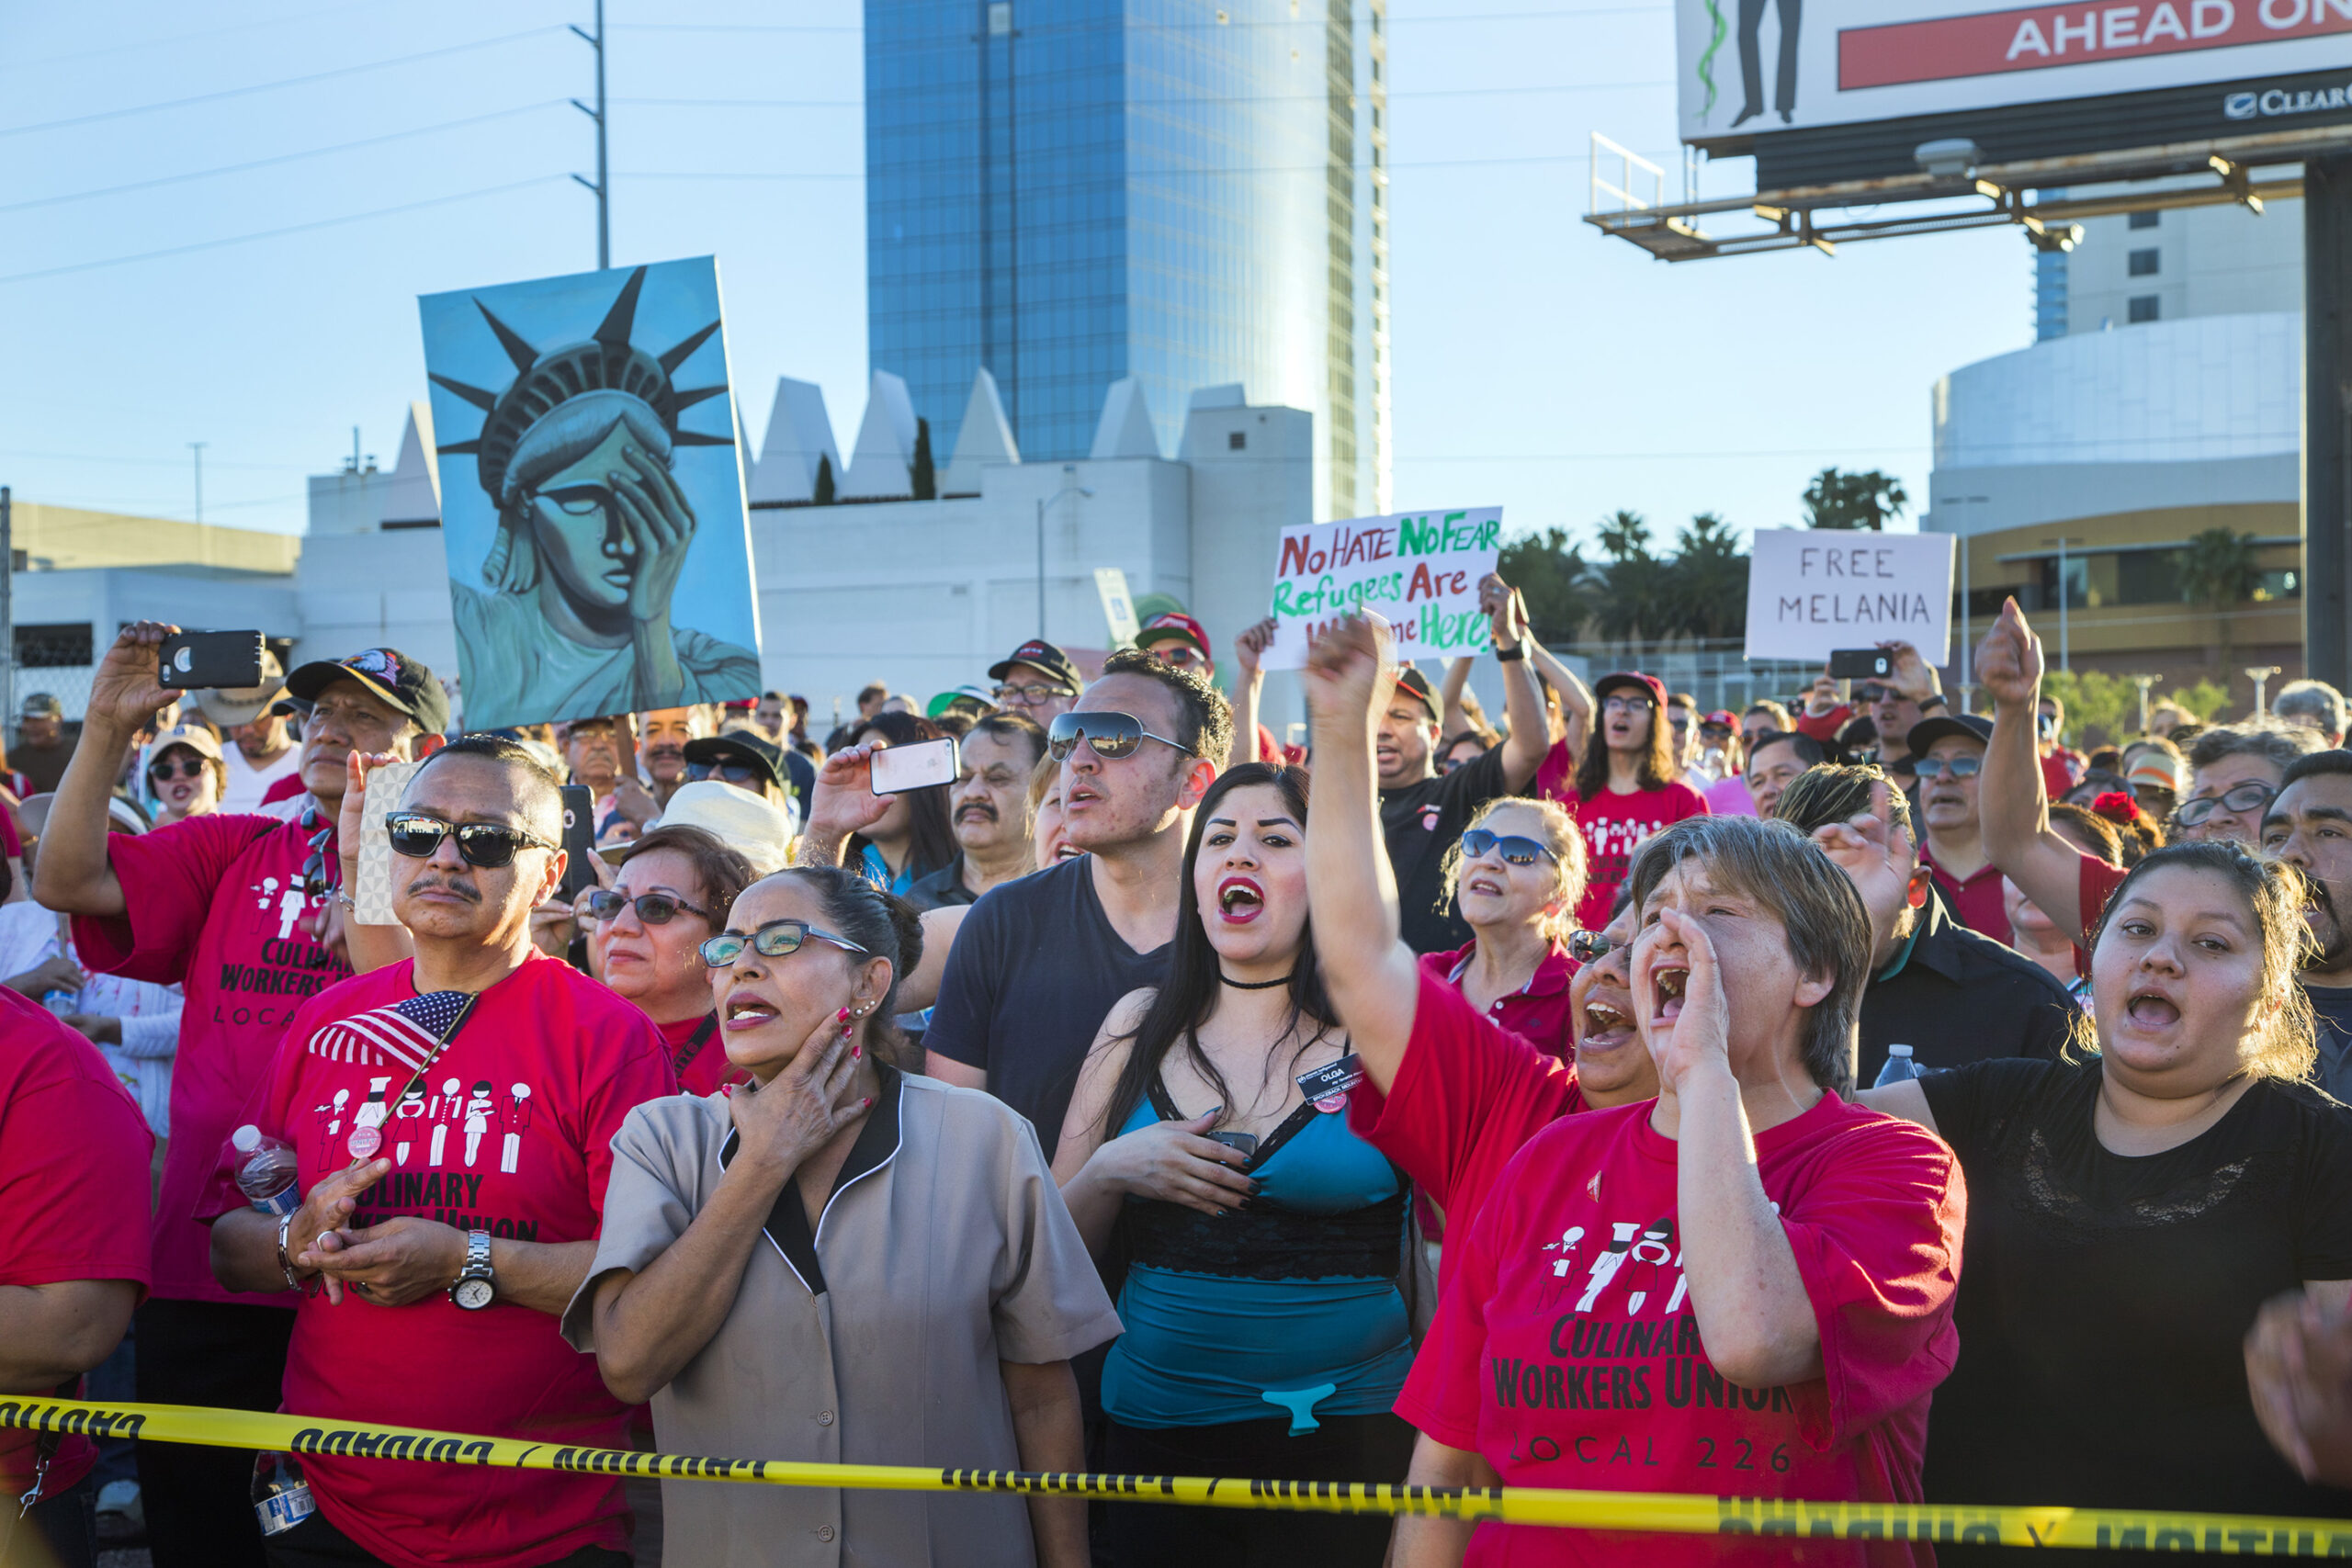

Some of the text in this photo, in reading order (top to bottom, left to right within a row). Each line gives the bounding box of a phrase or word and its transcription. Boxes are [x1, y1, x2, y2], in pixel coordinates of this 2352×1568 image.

[2006, 0, 2235, 61] AHEAD
[1329, 526, 1396, 570] HATE
[1801, 547, 1894, 578] FREE
[1272, 562, 1468, 621] Refugees Are
[1779, 593, 1931, 624] MELANIA
[1420, 604, 1492, 653] Here!
[220, 964, 324, 997] WORKERS
[213, 1006, 296, 1026] LOCA
[1320, 1068, 1345, 1082] OLGA
[356, 1172, 484, 1209] ULINARY
[1550, 1313, 1700, 1359] CULINAR
[1492, 1358, 1652, 1410] WORKERS
[1510, 1431, 1791, 1473] LOCAL 226
